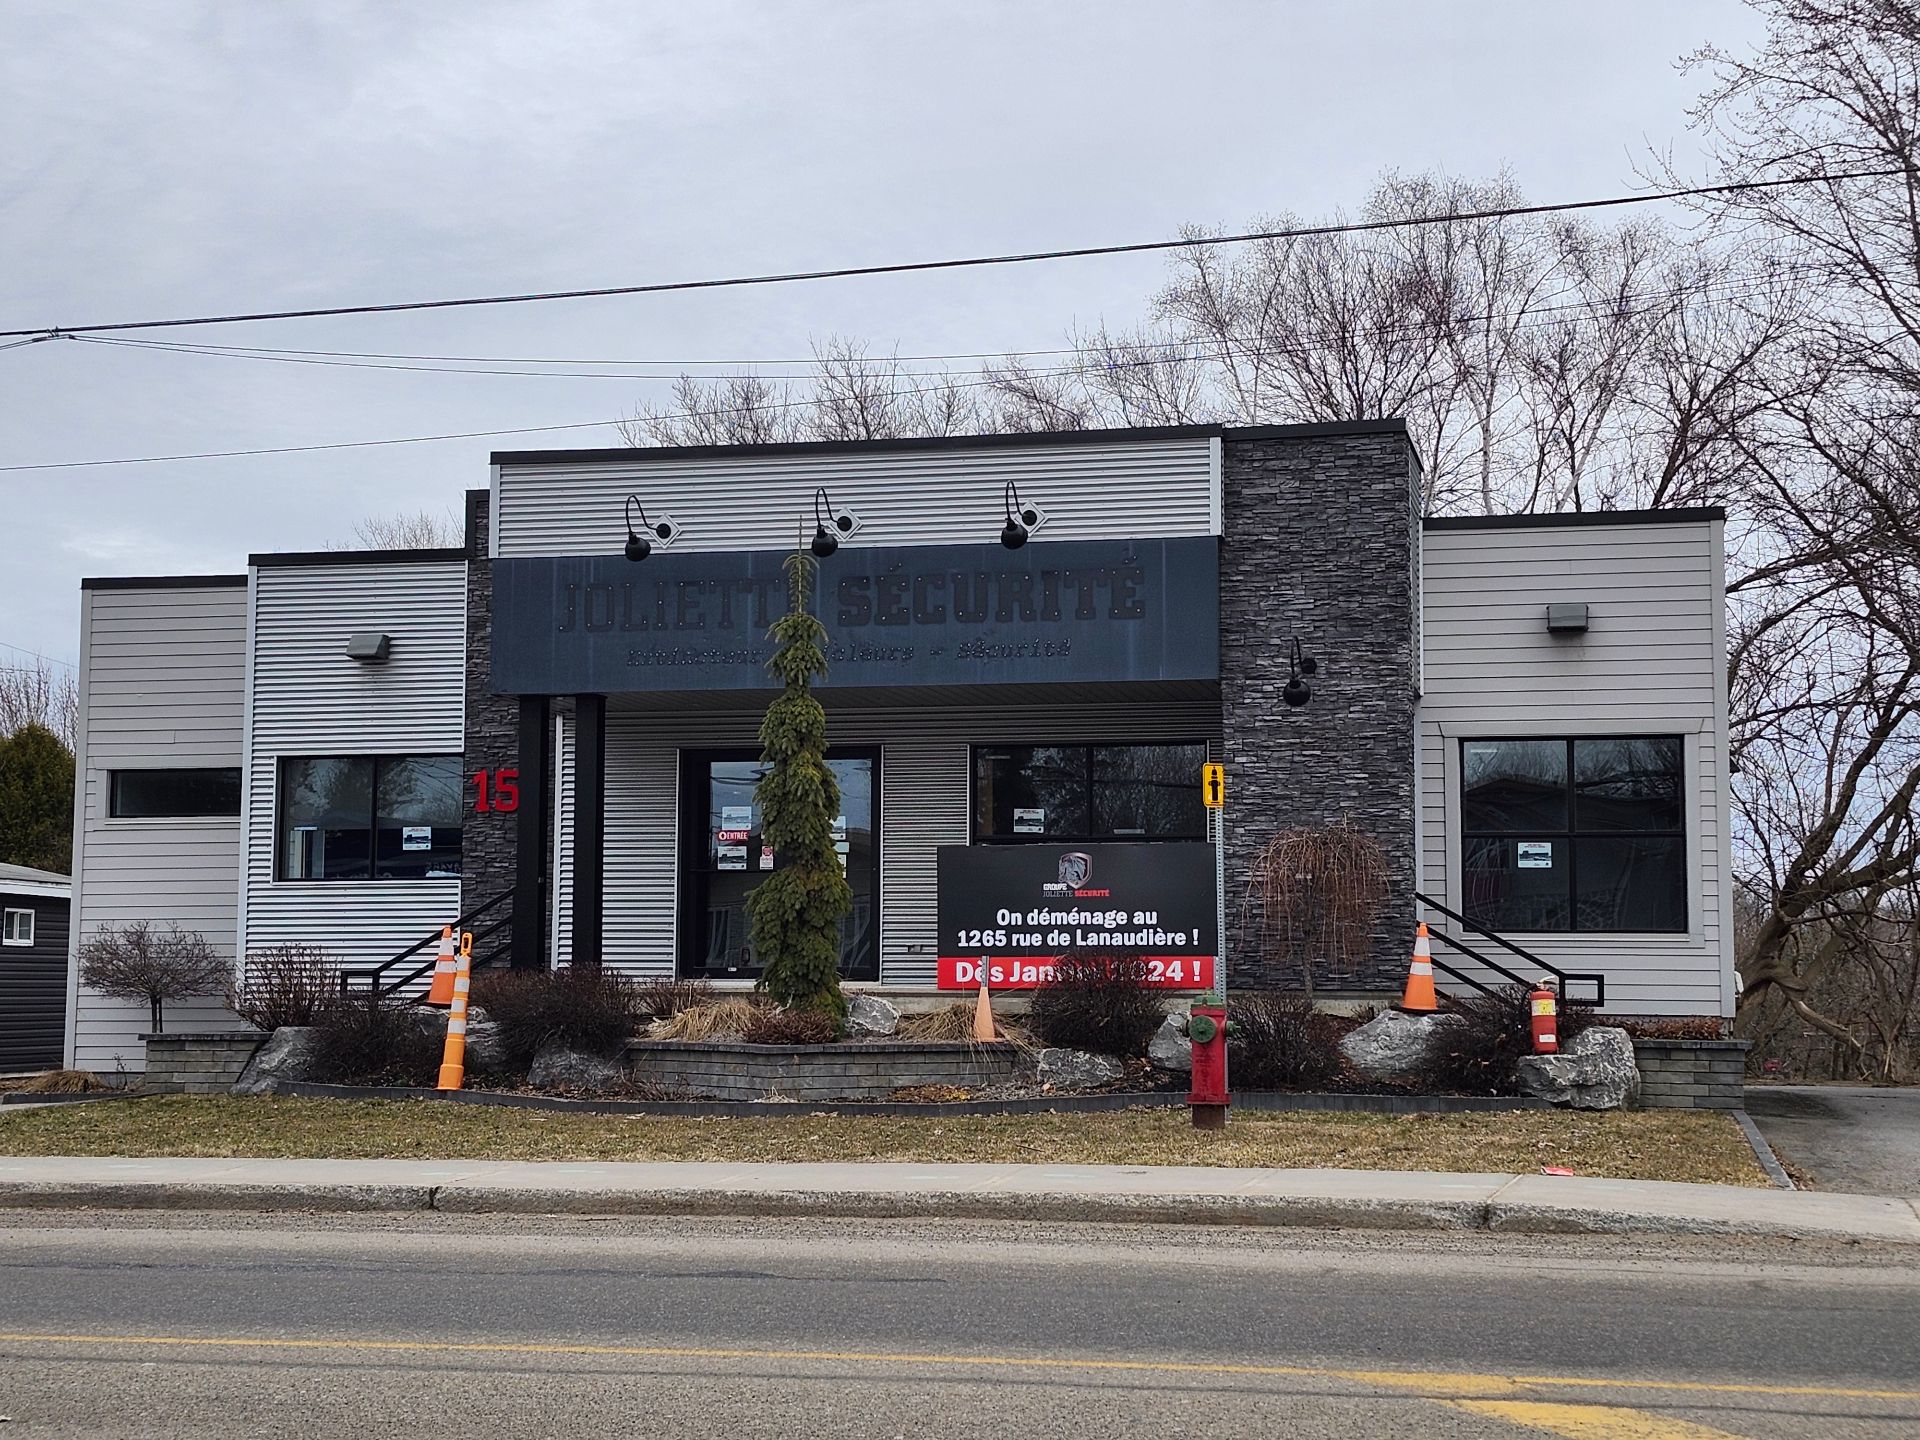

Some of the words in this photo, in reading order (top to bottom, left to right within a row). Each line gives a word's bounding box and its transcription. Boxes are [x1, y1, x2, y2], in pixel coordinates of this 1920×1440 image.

[837, 553, 1146, 627] SÉCURITÉ
[472, 768, 519, 812] 15
[1042, 890, 1073, 898] JOLIETTE
[1074, 888, 1110, 897] SÉCURITÉ
[1043, 883, 1068, 891] GROUPE
[996, 909, 1022, 926] On
[1027, 907, 1128, 928] déménage
[1133, 911, 1157, 925] au
[957, 930, 1007, 947] 1265
[1011, 933, 1043, 947] rue
[1047, 929, 1071, 946] de
[1076, 928, 1186, 946] Lanaudière
